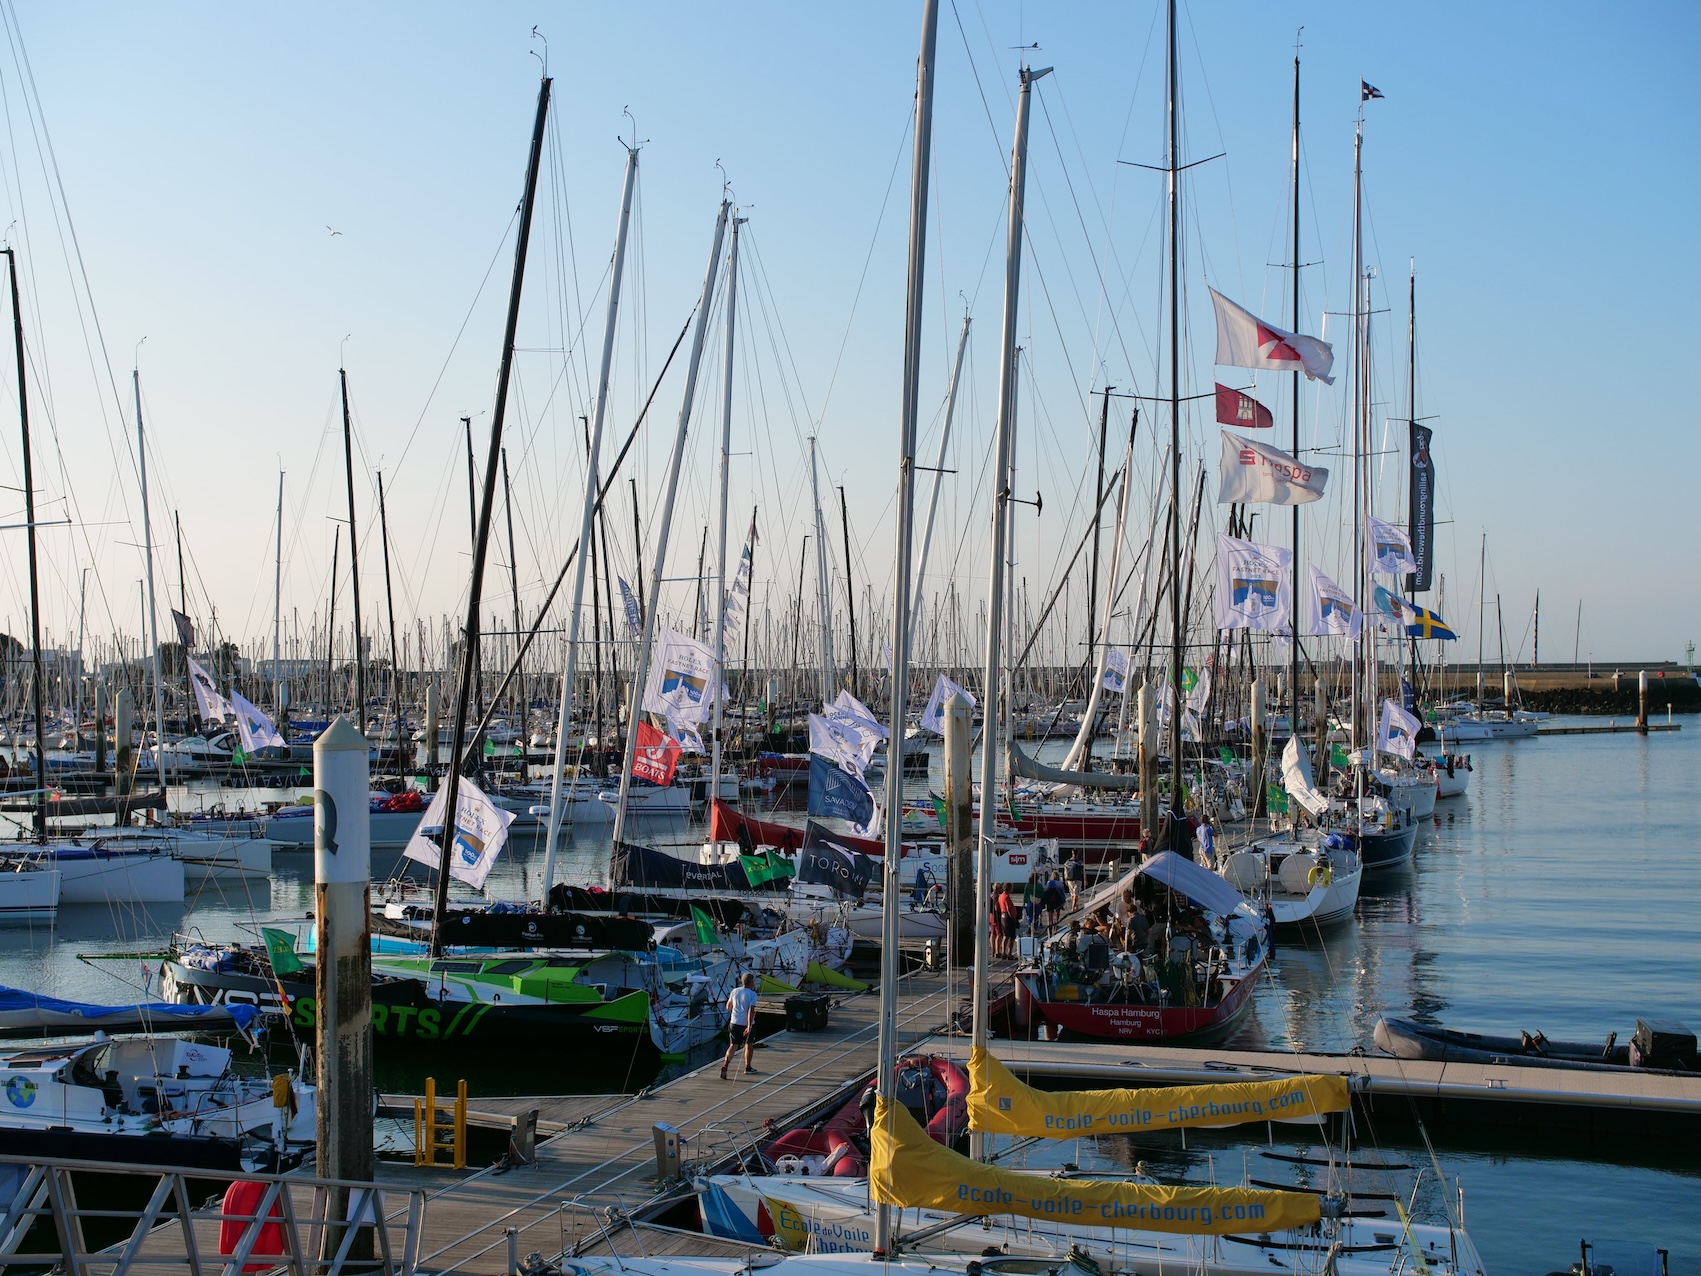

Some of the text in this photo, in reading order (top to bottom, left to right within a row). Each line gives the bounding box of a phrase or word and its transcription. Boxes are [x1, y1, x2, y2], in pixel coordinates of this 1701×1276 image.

[1232, 566, 1261, 574] FASTNET
[668, 659, 709, 675] FASTNET RACE
[678, 655, 702, 666] ROLEX
[634, 762, 666, 781] BOATS
[456, 812, 492, 838] STNET RACE
[461, 807, 487, 825] ROLEX
[294, 997, 441, 1040] SRTS
[1092, 1007, 1160, 1020] Haspa Hamburg
[1110, 1018, 1142, 1028] Hamburg
[1118, 1027, 1133, 1035] NRV
[1045, 1090, 1305, 1130] ecole-voile-cherbourg.com
[958, 1183, 1265, 1226] ecole-voile-cherbourg.com
[780, 1210, 870, 1244] Ecole de Voile
